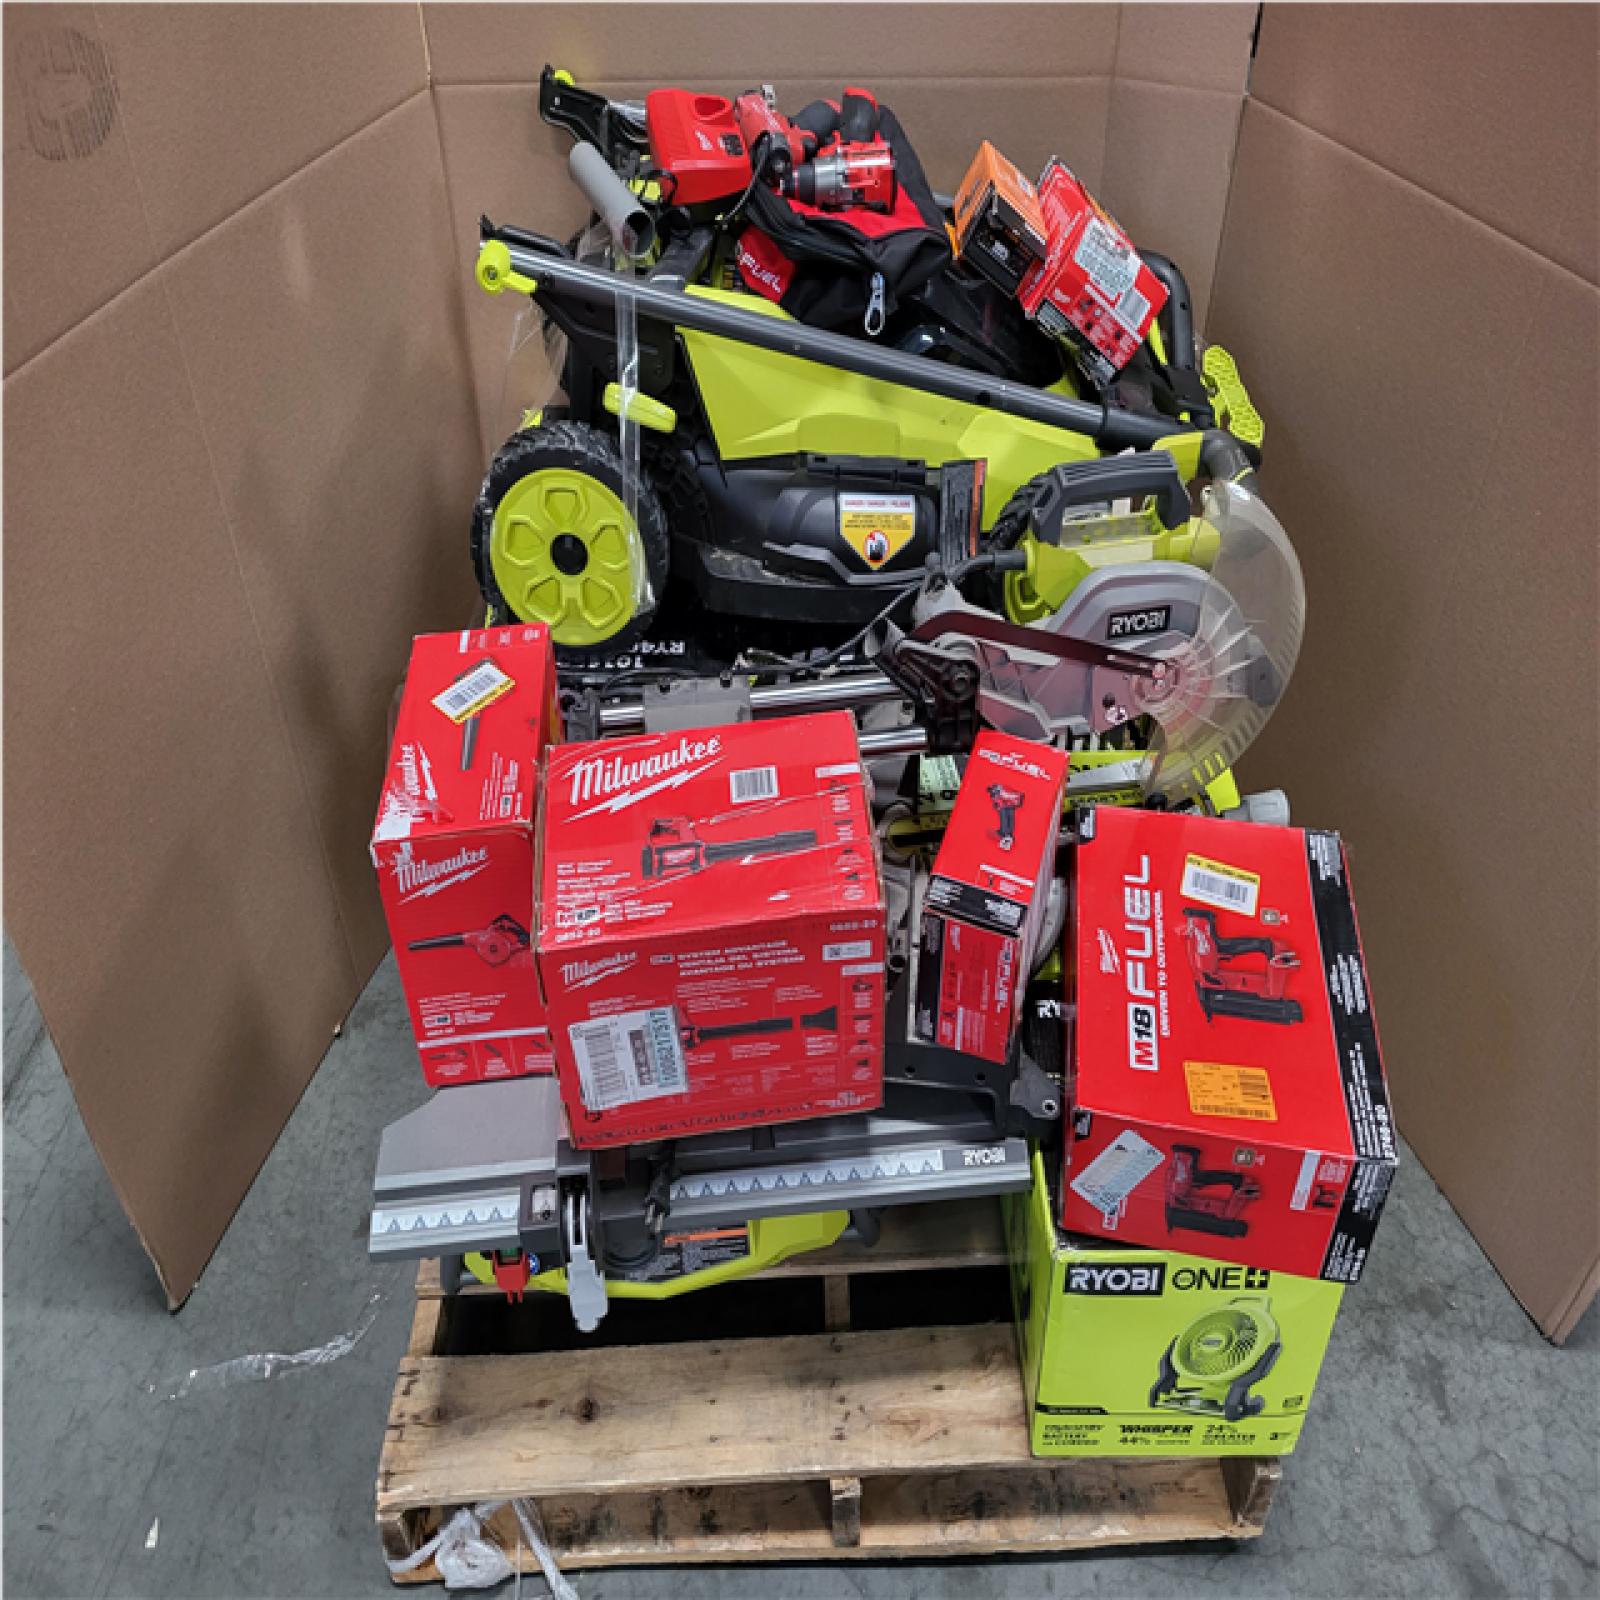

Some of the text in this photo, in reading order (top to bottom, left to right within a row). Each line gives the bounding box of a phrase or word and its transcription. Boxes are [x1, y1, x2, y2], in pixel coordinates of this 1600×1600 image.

[1109, 608, 1167, 637] RYOBI
[561, 735, 722, 806] Milwaukee
[391, 847, 489, 893] Milwaukee
[560, 950, 637, 986] Milwaukee
[1123, 854, 1157, 1068] M18 FUEL
[962, 1145, 1006, 1166] RYOBI
[1069, 1267, 1271, 1292] RYOBI ONE+
